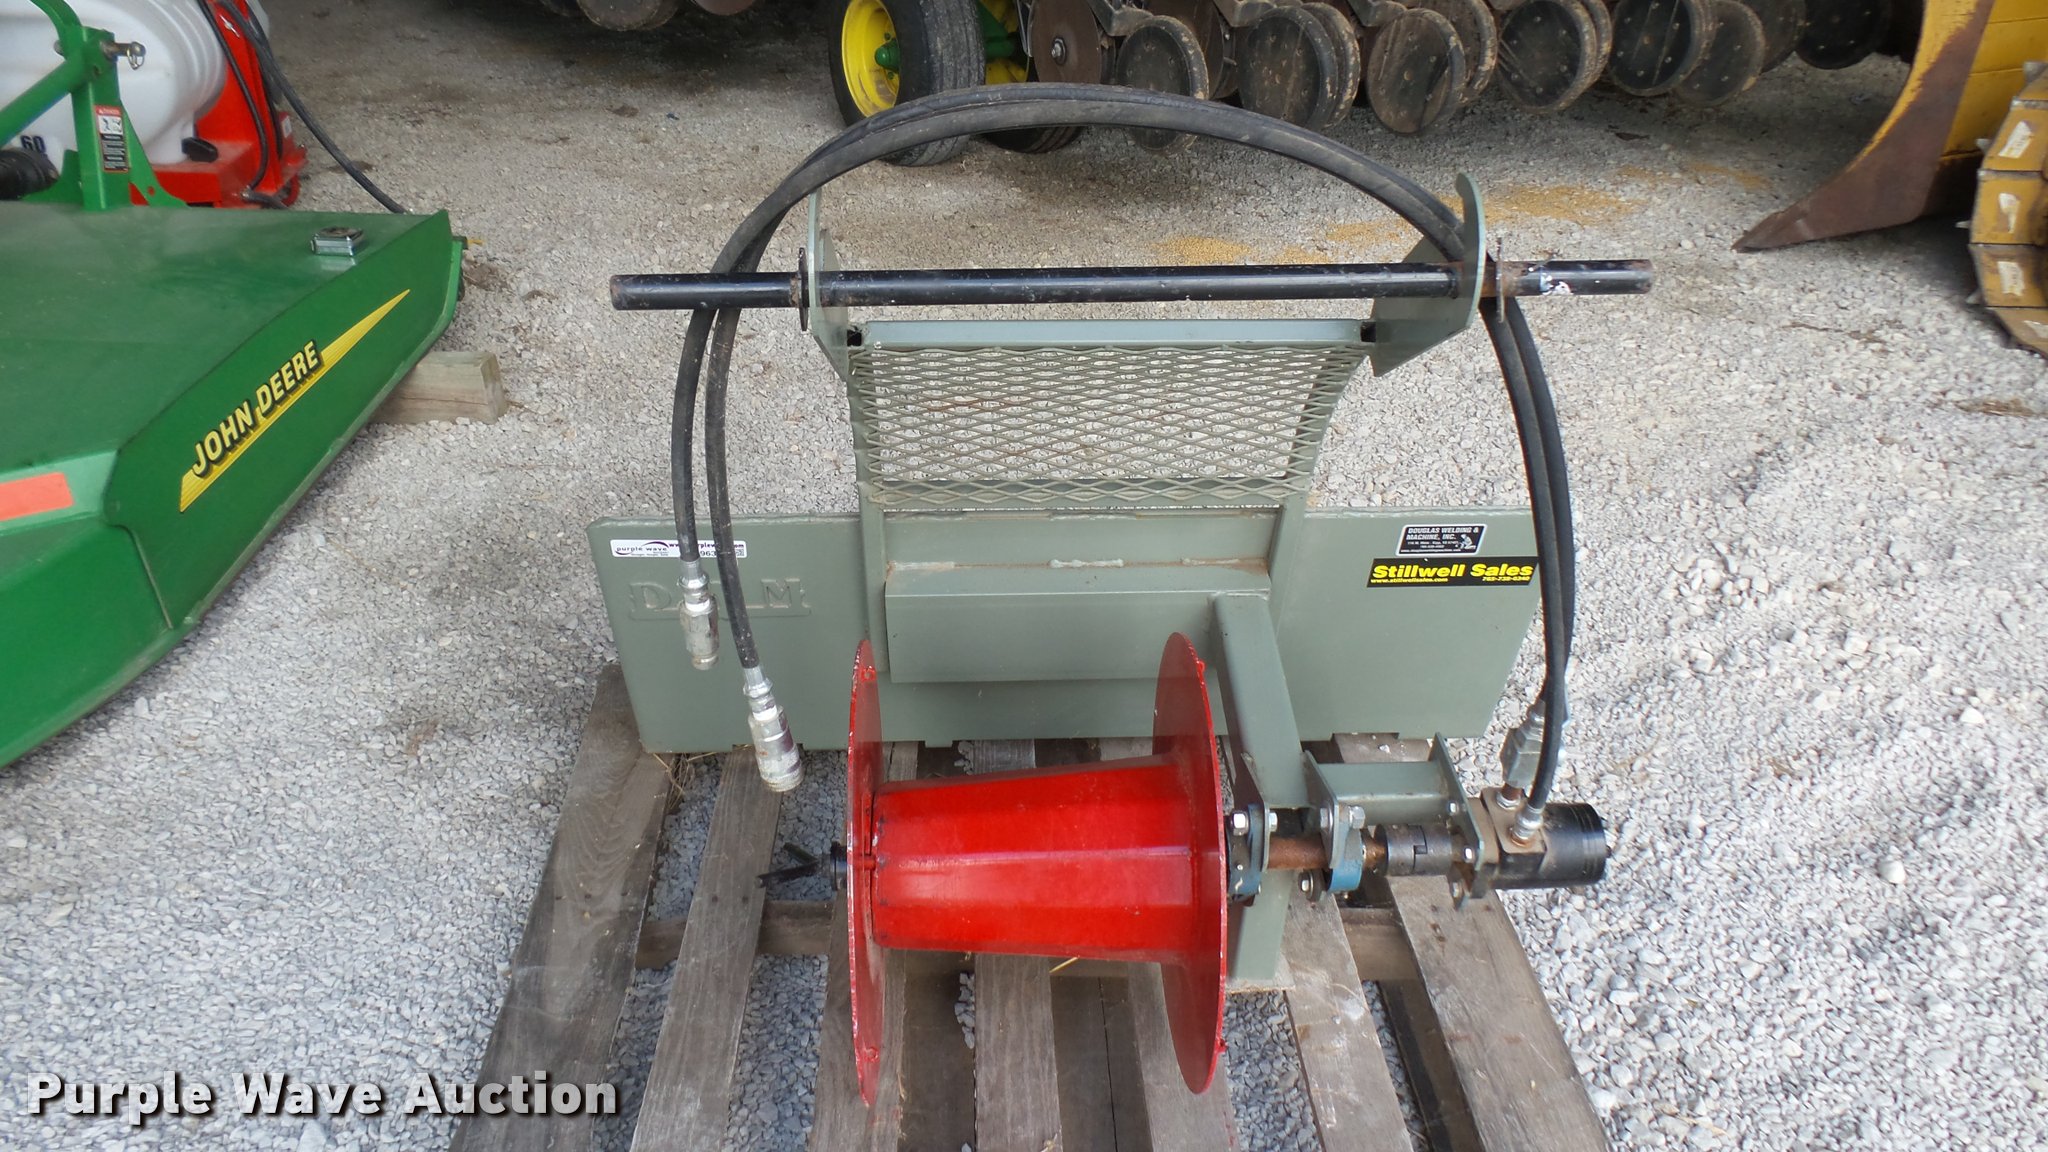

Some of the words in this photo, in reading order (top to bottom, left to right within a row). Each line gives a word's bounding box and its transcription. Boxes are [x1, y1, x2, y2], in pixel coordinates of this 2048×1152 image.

[192, 399, 256, 477] JOHN
[256, 339, 321, 416] DEERE
[1372, 564, 1466, 578] Stillwell
[1470, 563, 1533, 577] Sales
